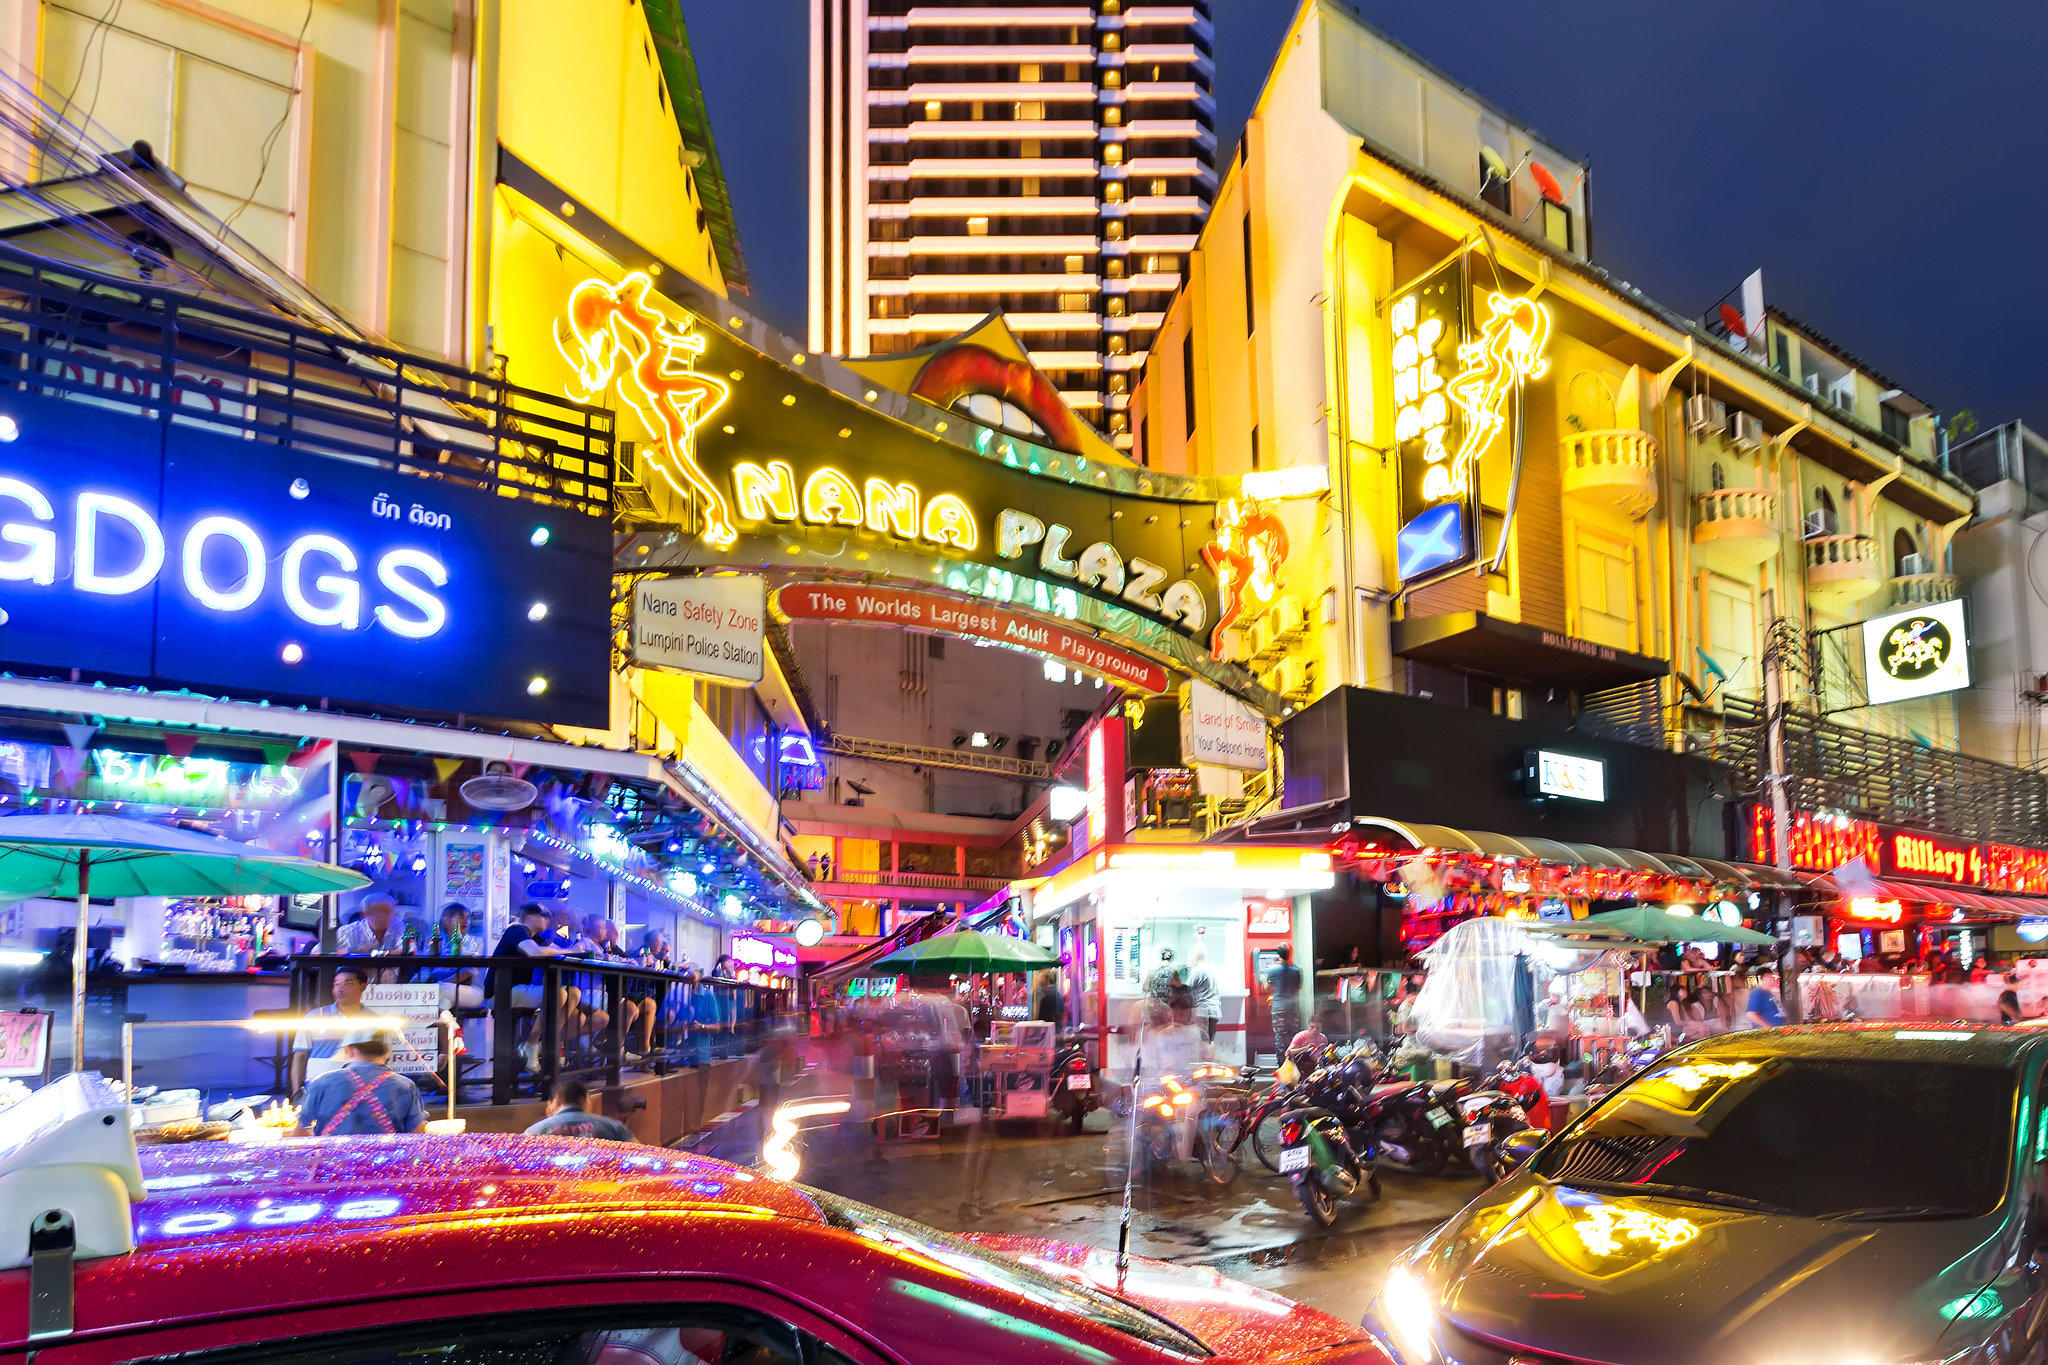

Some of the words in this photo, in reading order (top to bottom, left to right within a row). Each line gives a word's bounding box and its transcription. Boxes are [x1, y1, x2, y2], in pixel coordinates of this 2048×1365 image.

[371, 491, 401, 521] บิ๊ก
[408, 502, 452, 531] ด๊อก
[731, 460, 979, 551] NANA
[994, 507, 1207, 636] PLAZA
[642, 591, 678, 616] Nana
[683, 599, 724, 630] Safety
[728, 608, 760, 633] Zone
[639, 625, 685, 653] Lumpini
[687, 634, 720, 659] Police
[723, 640, 760, 666] Station
[807, 592, 847, 613] The
[856, 594, 922, 619] Worlds
[931, 603, 998, 632] Largest
[1004, 619, 1050, 646] Adult
[1060, 635, 1150, 683] Playground
[1541, 631, 1598, 657] HOLLYWOOD
[1600, 645, 1617, 661] INN
[1198, 708, 1222, 728] Land
[1224, 714, 1235, 729] of
[1235, 714, 1262, 734] Smile
[1216, 736, 1243, 756] Second
[1893, 834, 1966, 884] Hillary
[1969, 845, 1982, 885] 4
[392, 1053, 435, 1062] RUG
